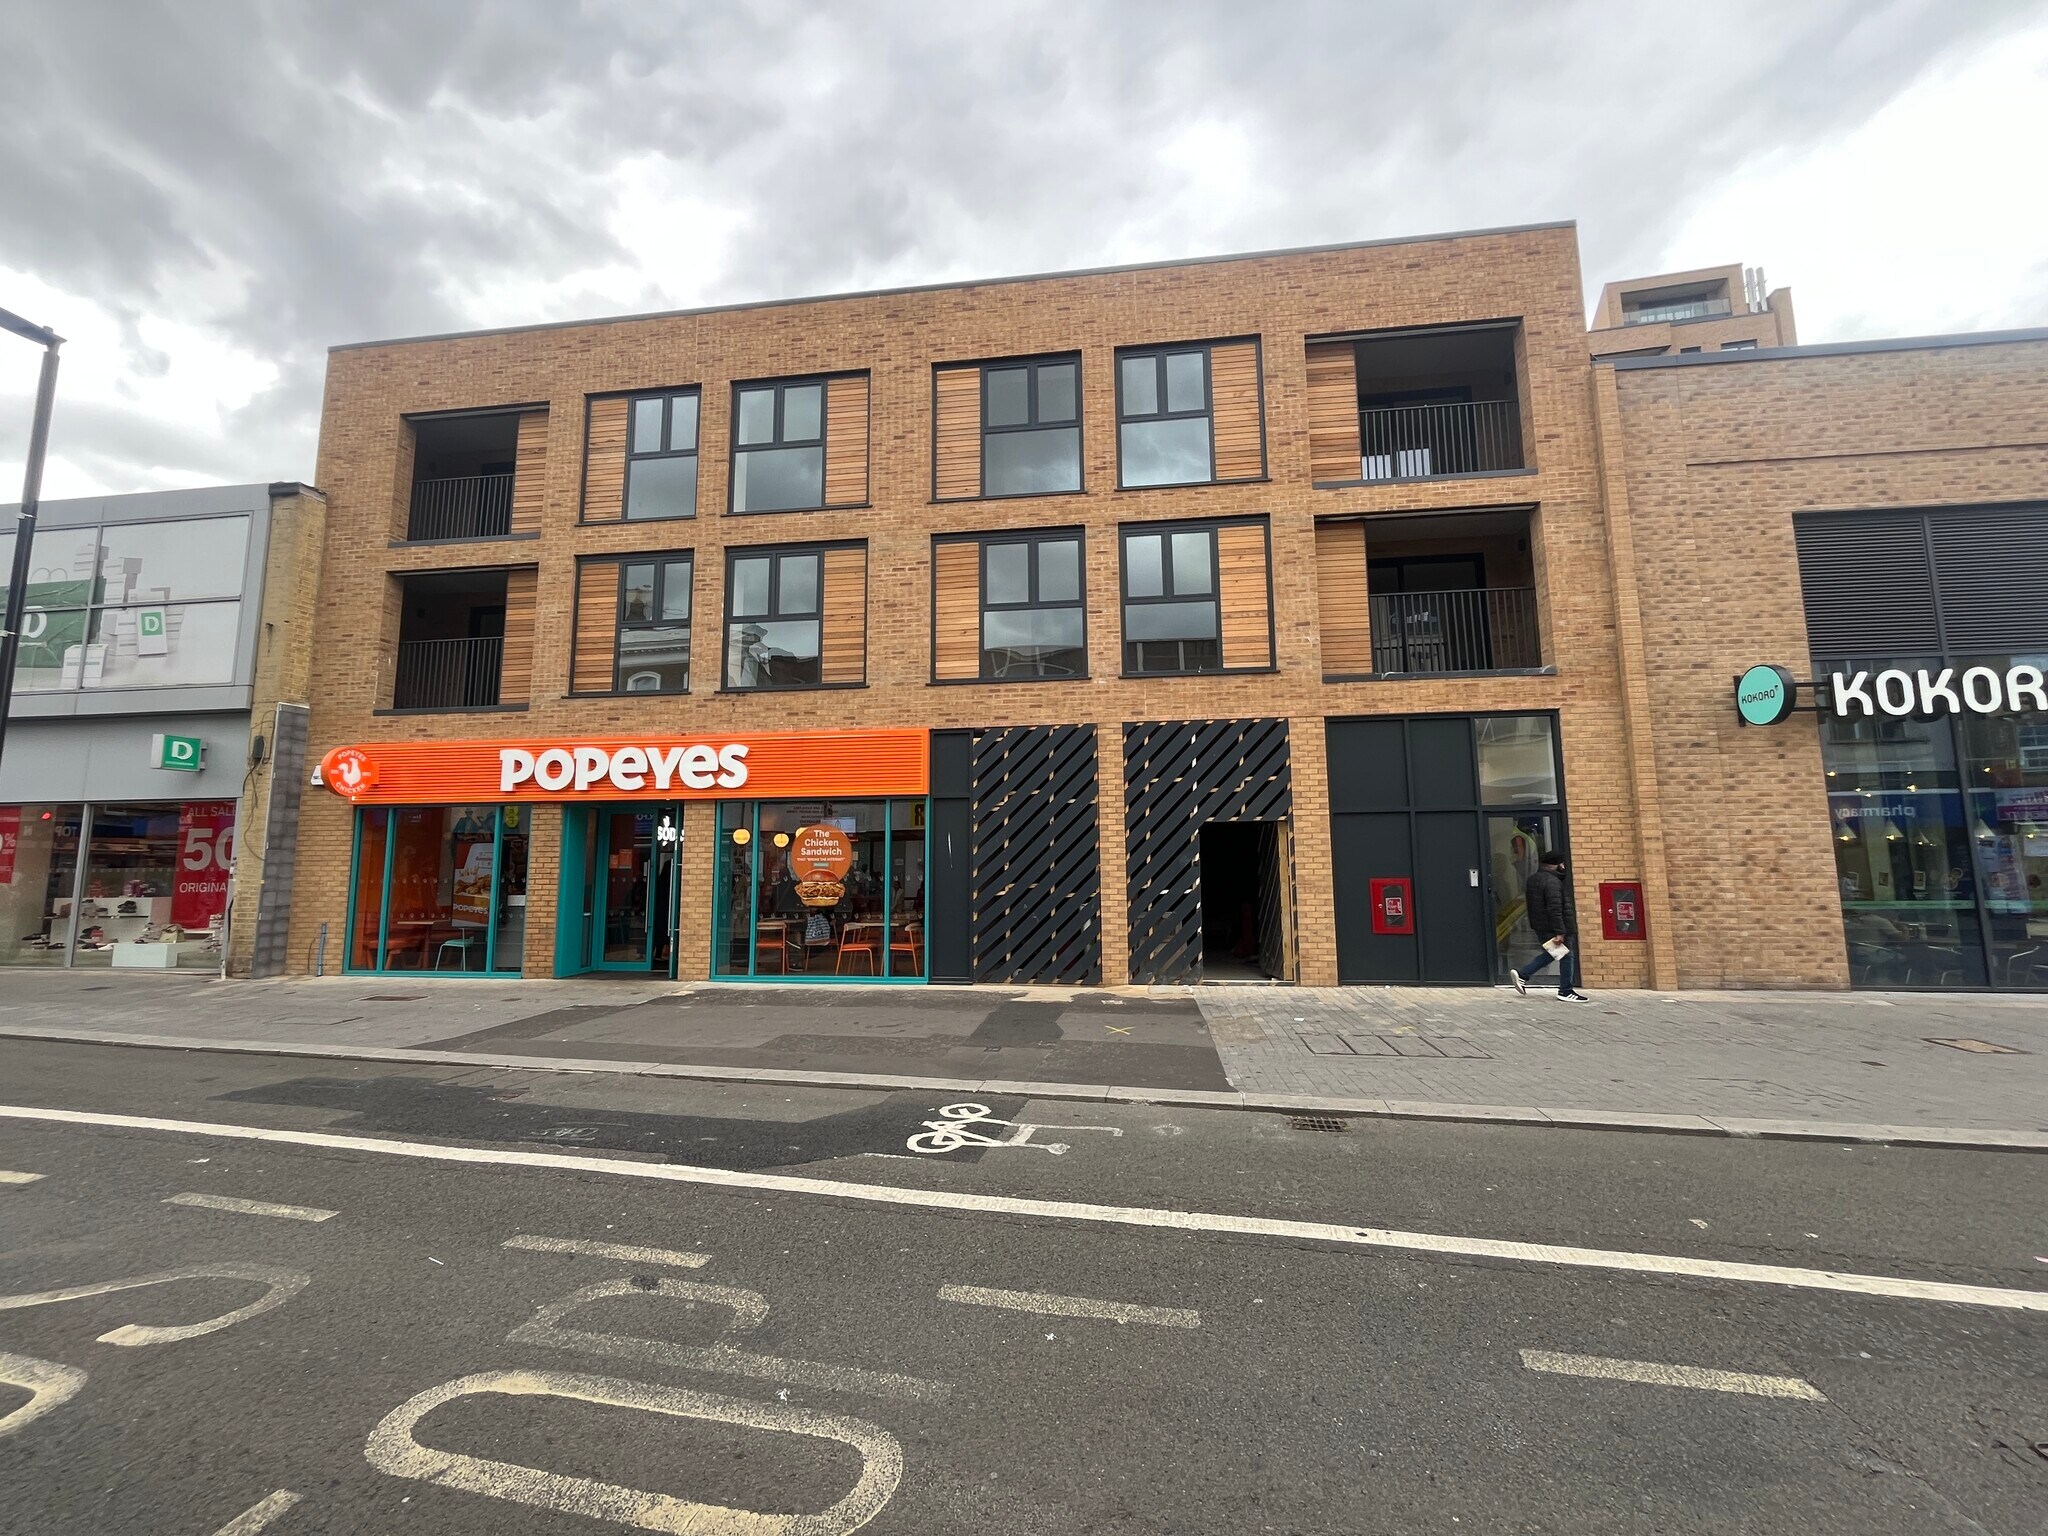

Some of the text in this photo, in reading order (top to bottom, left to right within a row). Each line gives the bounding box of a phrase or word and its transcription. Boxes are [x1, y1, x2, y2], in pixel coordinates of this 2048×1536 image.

[145, 616, 160, 632] D
[1741, 690, 1776, 705] KOKORO
[172, 741, 194, 760] D
[337, 750, 367, 762] POPEYES
[335, 781, 366, 794] CHICKEN
[188, 807, 208, 817] ALL
[814, 829, 830, 838] The
[804, 838, 839, 847] Chicken
[800, 847, 842, 856] Sandwich
